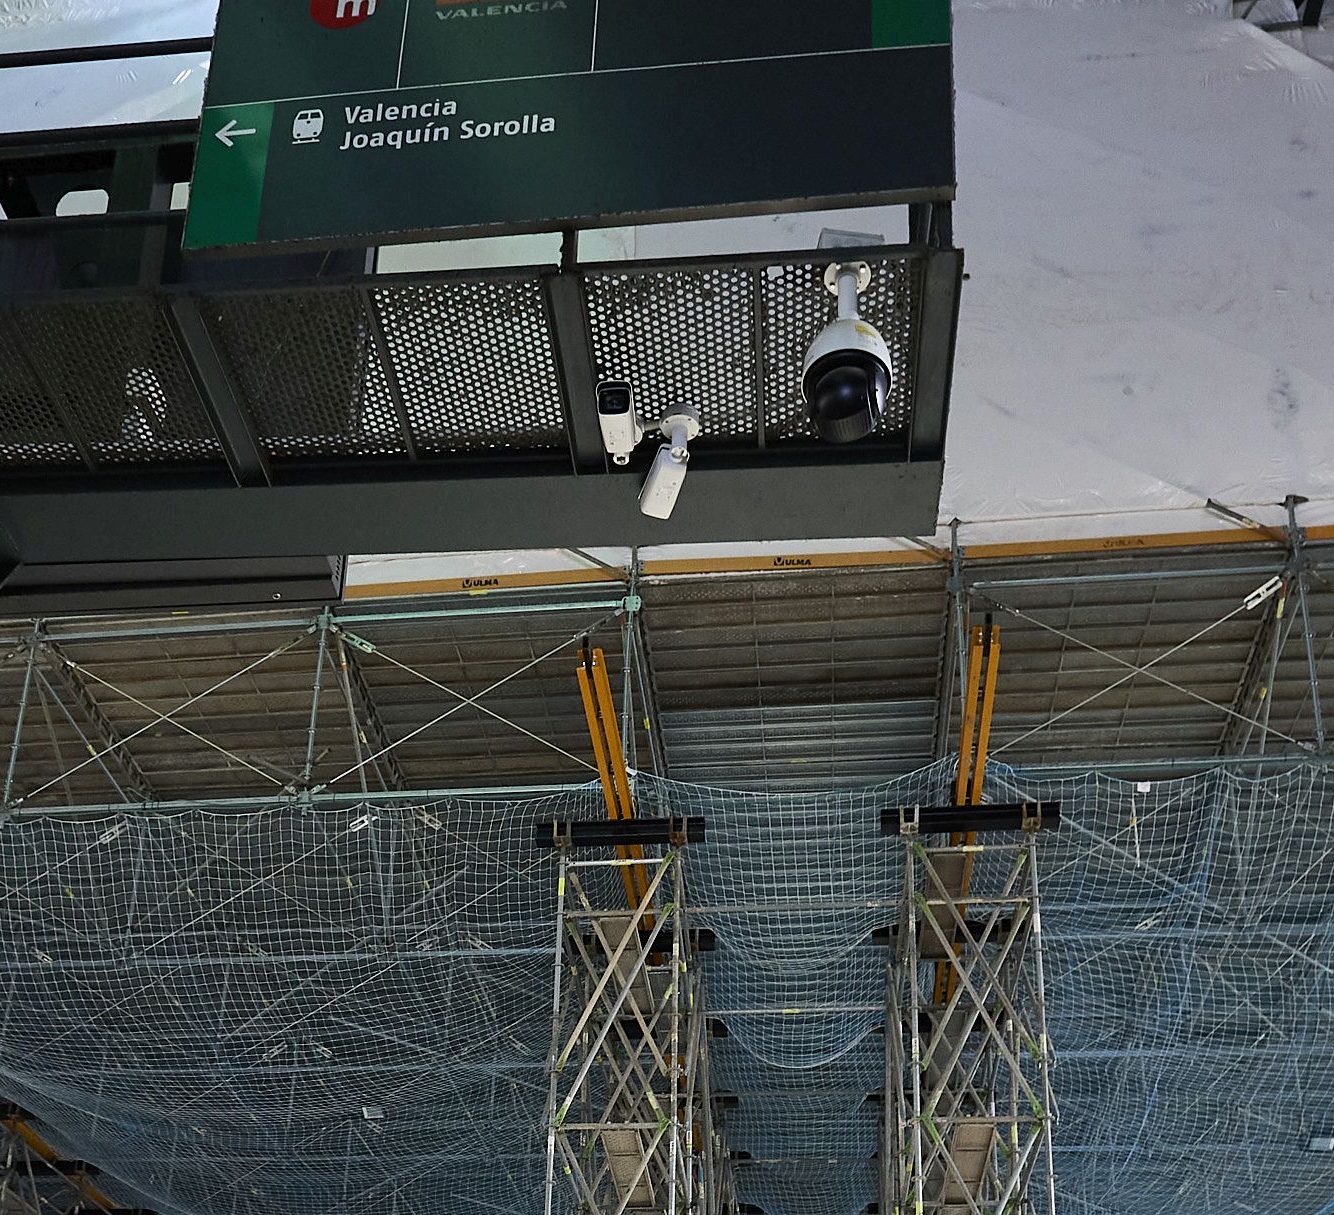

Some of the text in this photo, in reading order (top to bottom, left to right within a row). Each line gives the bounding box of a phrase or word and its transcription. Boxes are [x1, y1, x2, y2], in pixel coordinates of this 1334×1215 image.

[435, 0, 568, 20] VALENCIA
[345, 99, 457, 124] Valencia
[339, 114, 556, 150] Joaquín Sorolla
